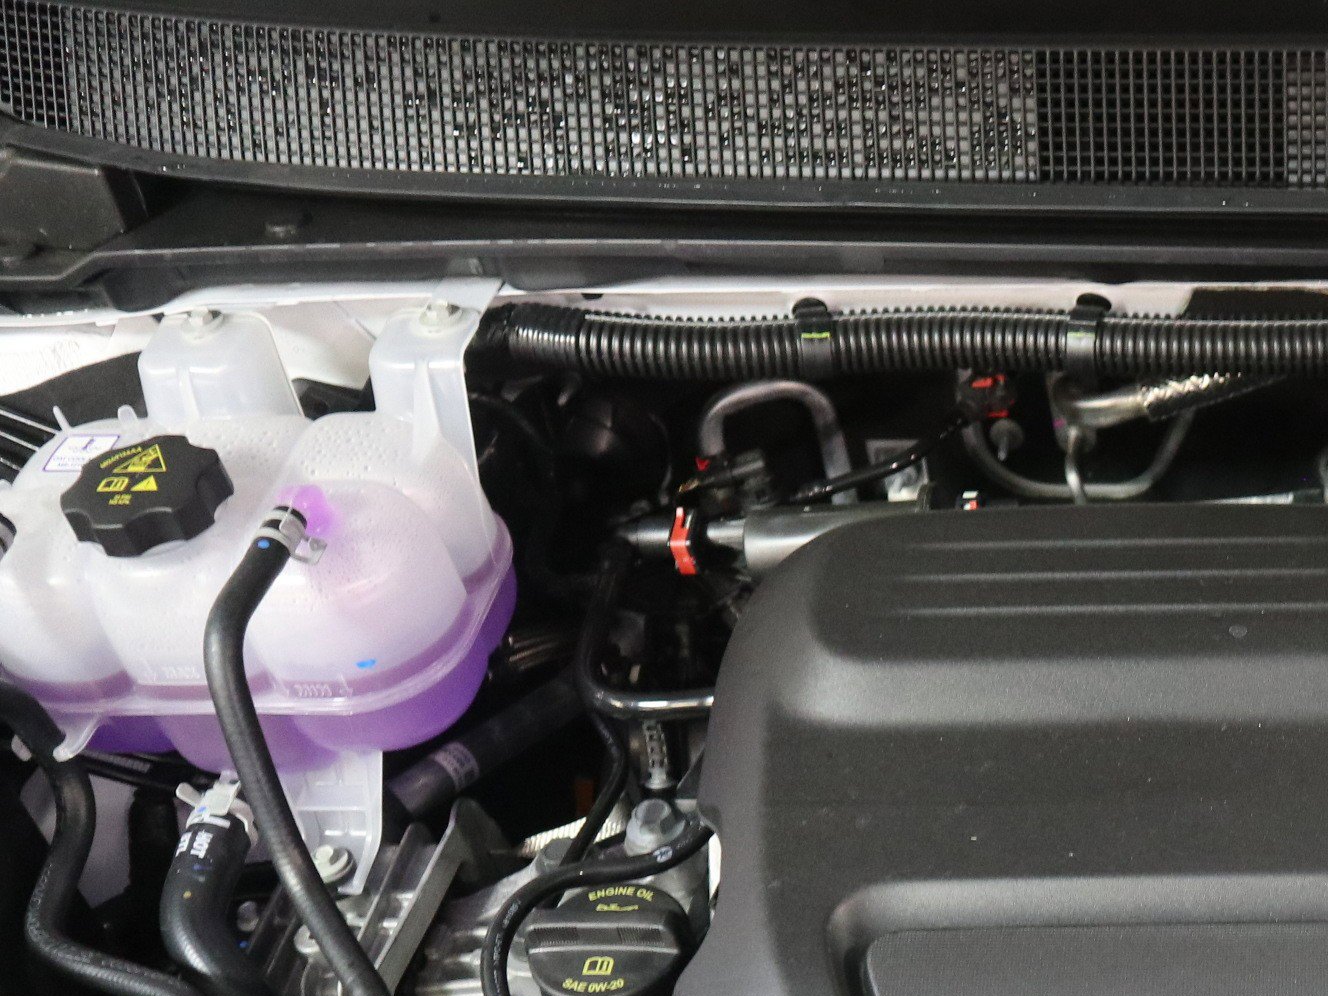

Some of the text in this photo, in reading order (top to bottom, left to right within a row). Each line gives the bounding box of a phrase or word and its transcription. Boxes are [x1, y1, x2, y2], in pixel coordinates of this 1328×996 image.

[589, 887, 653, 902] ENGINE OIL
[563, 978, 624, 993] SAE 0W-20
